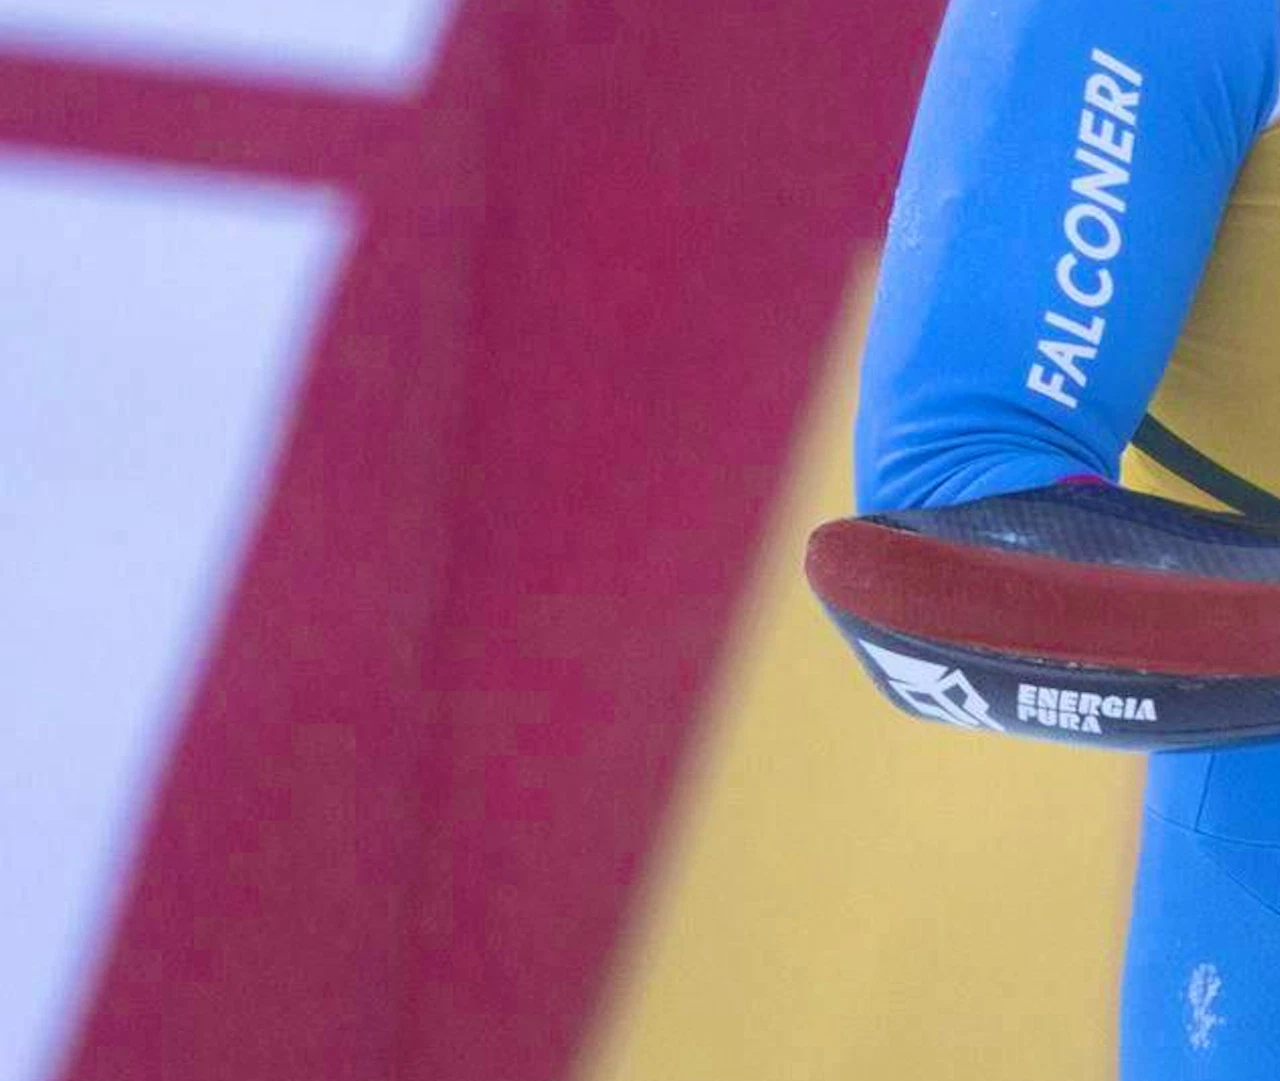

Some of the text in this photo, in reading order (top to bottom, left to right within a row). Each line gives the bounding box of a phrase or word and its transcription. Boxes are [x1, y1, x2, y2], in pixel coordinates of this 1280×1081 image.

[1026, 47, 1143, 409] FALCONERI
[1017, 683, 1158, 721] ENERGIA
[1017, 704, 1102, 734] PURA
